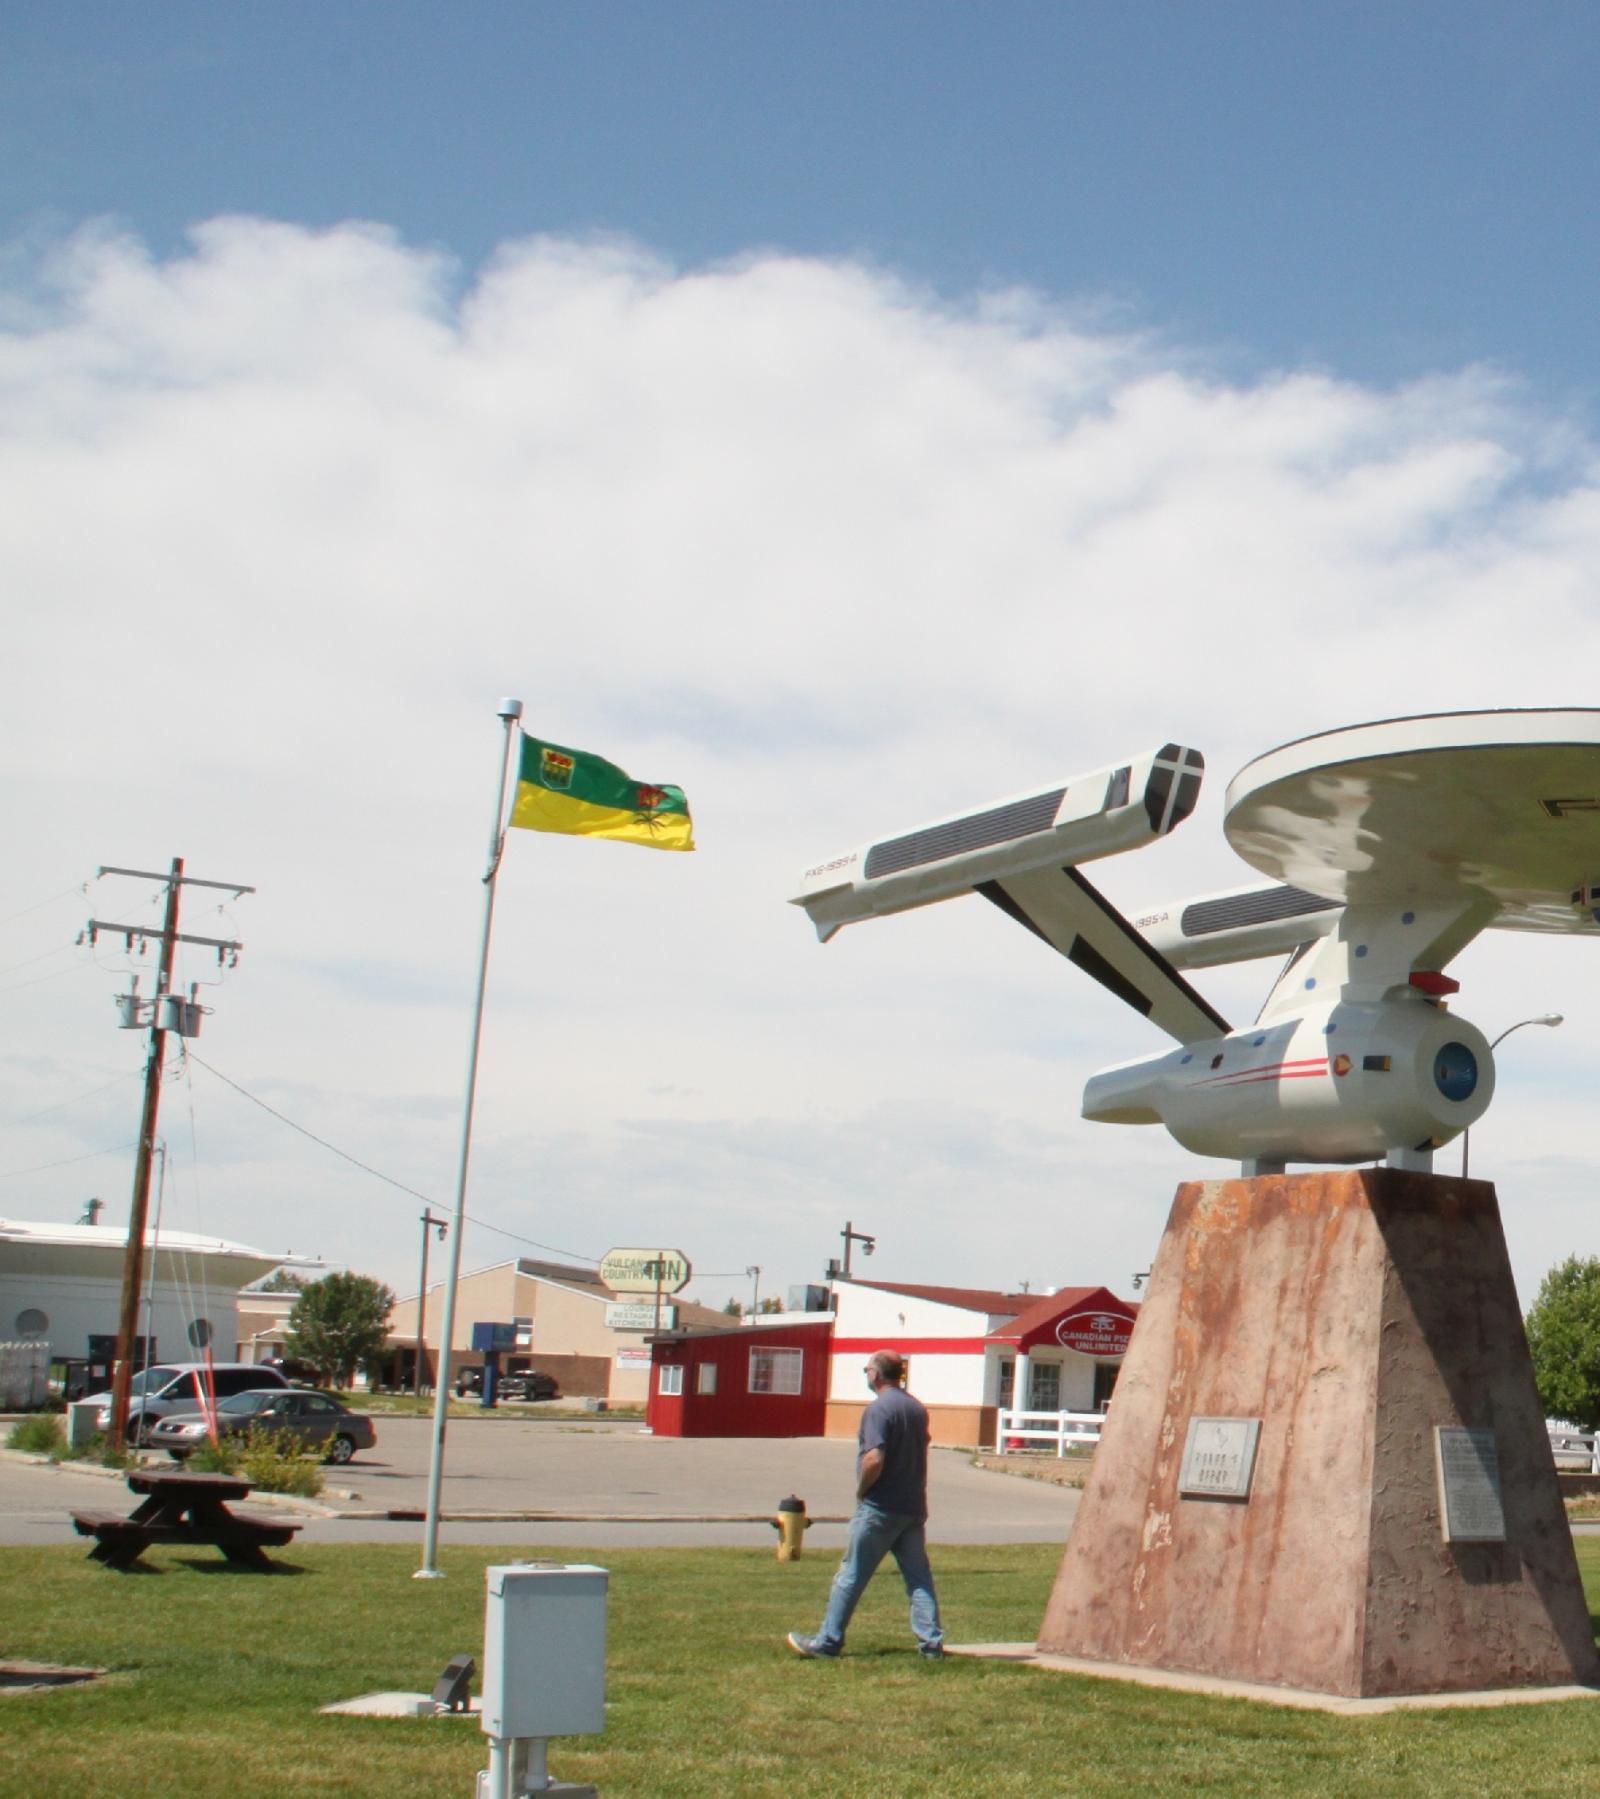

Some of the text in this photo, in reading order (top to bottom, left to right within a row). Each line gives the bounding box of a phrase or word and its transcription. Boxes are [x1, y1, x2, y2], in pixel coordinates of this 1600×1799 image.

[607, 1258, 643, 1269] VULCAN
[603, 1269, 645, 1280] COUNTRY
[613, 1311, 666, 1320] RESTAURAT
[1062, 1331, 1130, 1344] CANADIAN PIZ
[1075, 1341, 1127, 1352] UNLIMITED
